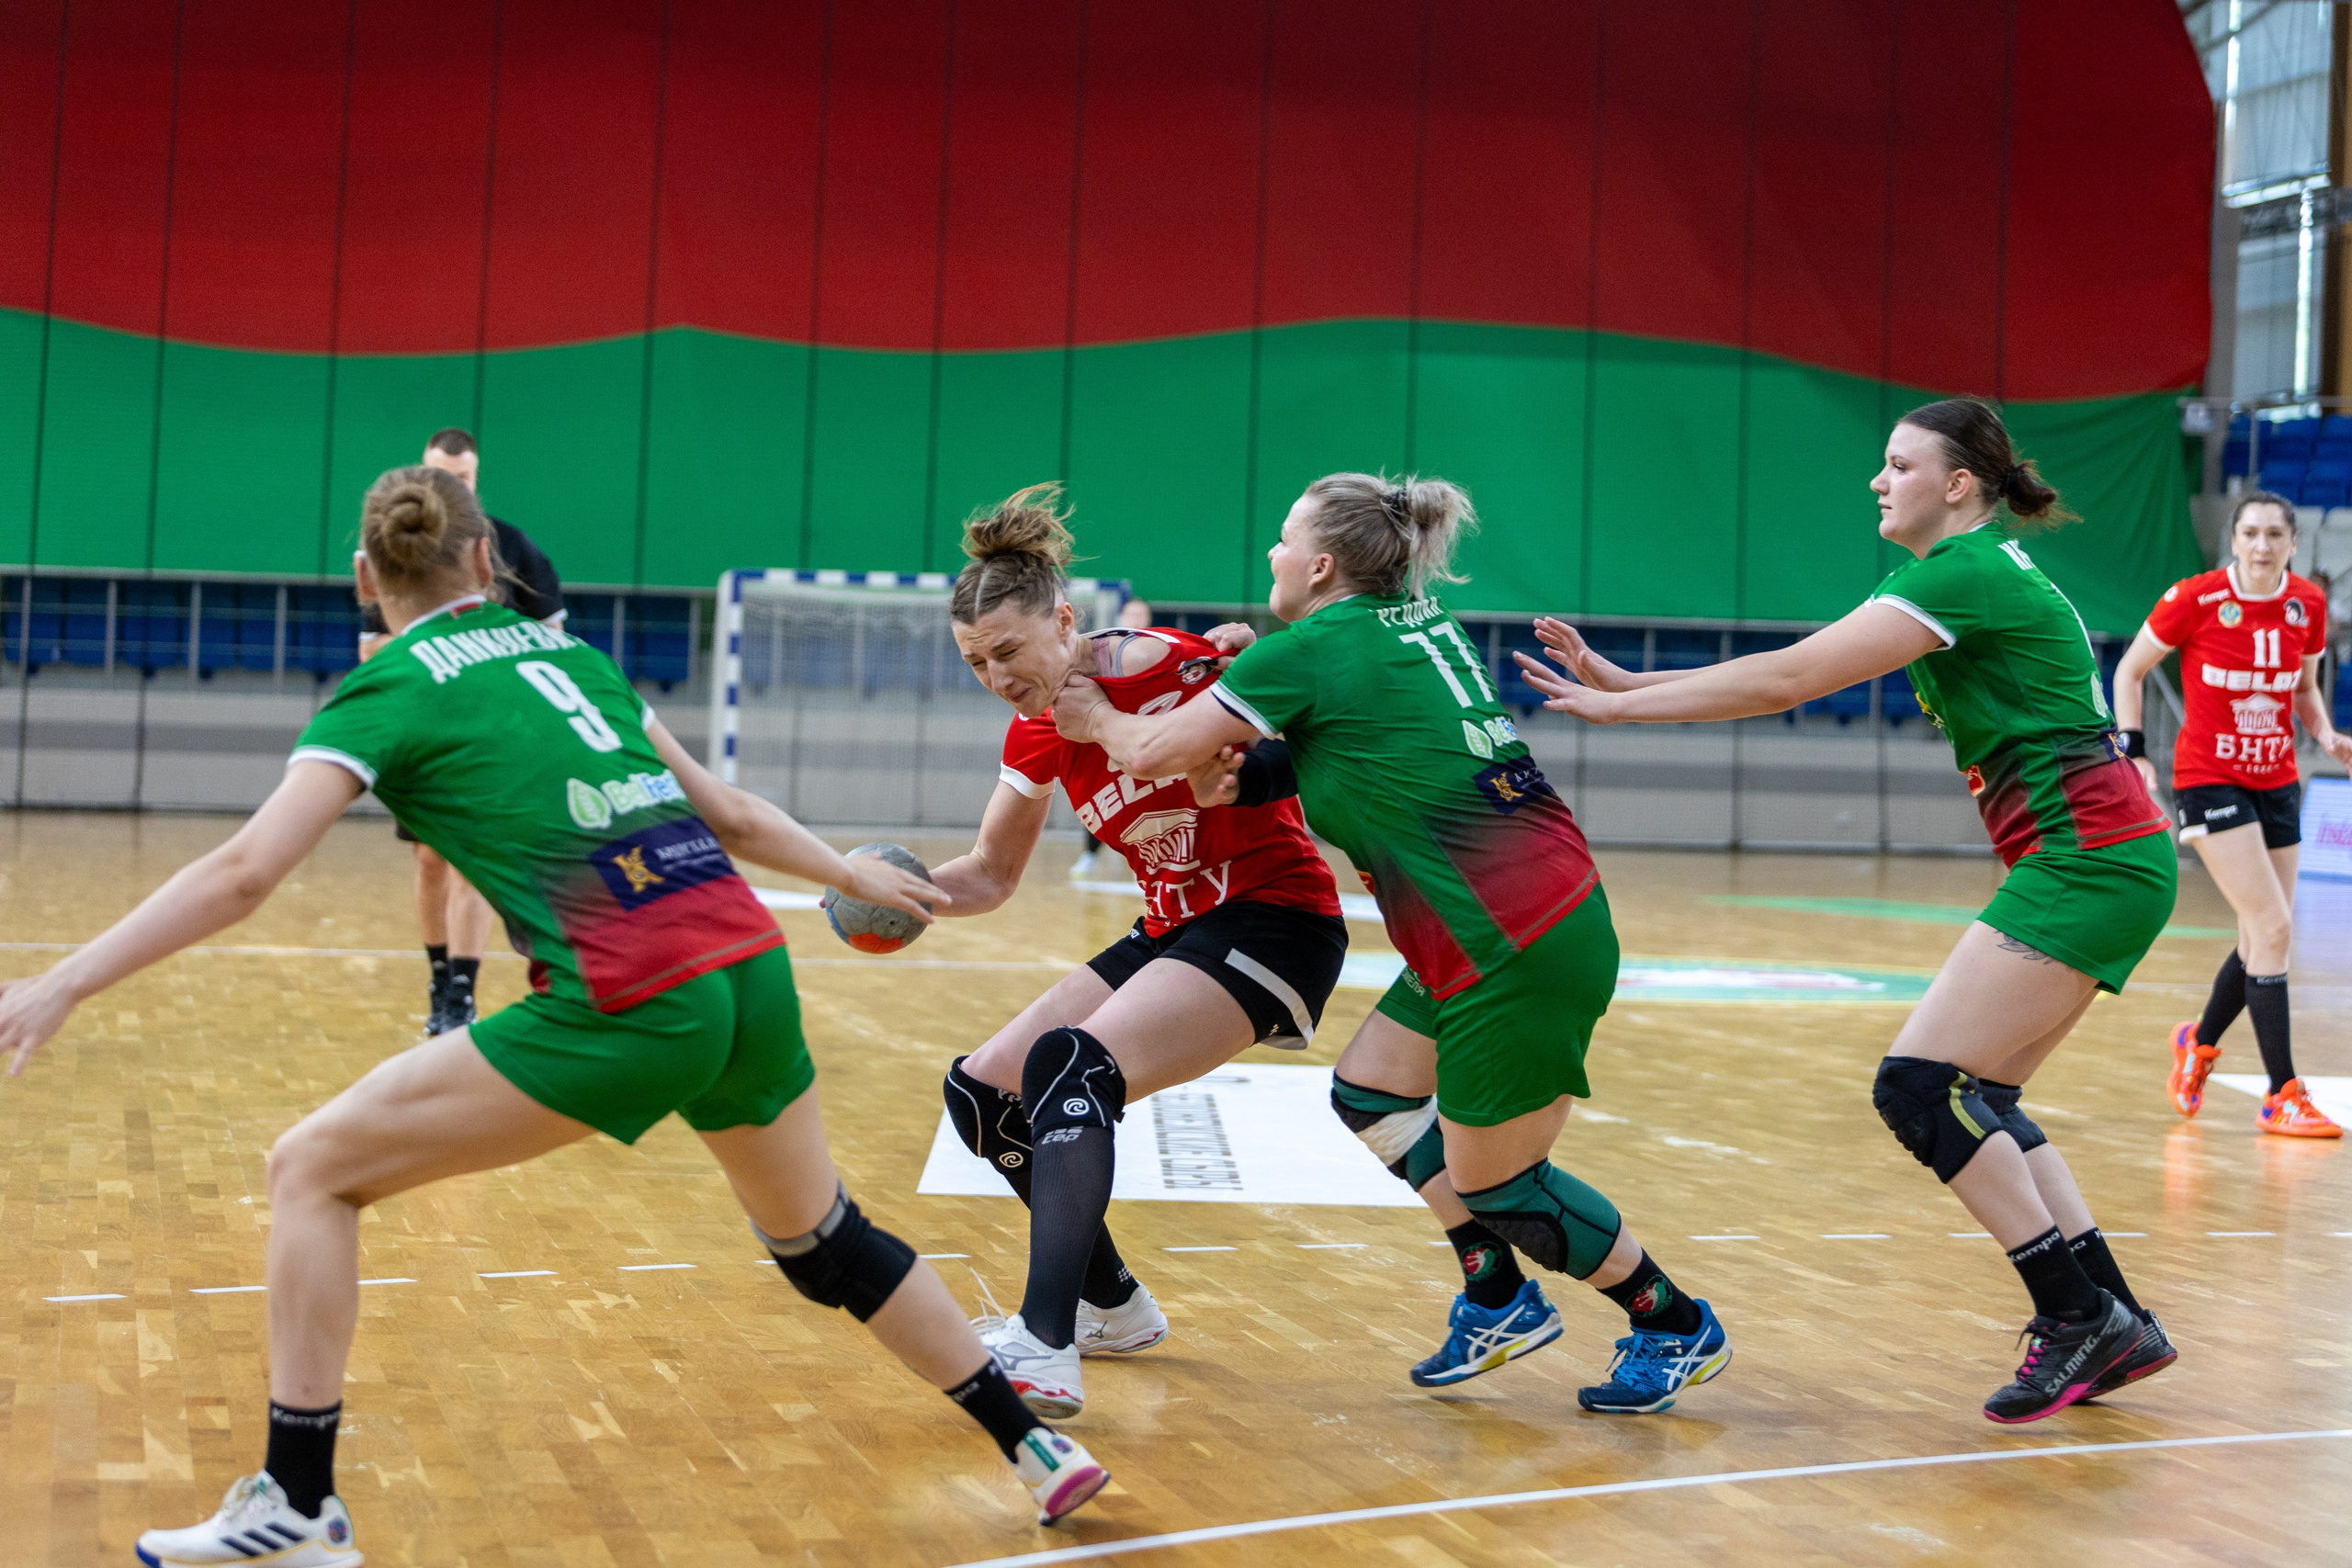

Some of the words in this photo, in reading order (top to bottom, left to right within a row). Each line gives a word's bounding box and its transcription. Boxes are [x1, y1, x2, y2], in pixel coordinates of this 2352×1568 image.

[1398, 621, 1495, 708] 77
[2253, 628, 2281, 668] 11
[515, 660, 623, 753] 9
[2215, 733, 2291, 763] БНТУ
[1075, 773, 1188, 834] BEL
[1138, 860, 1232, 919] НТУ
